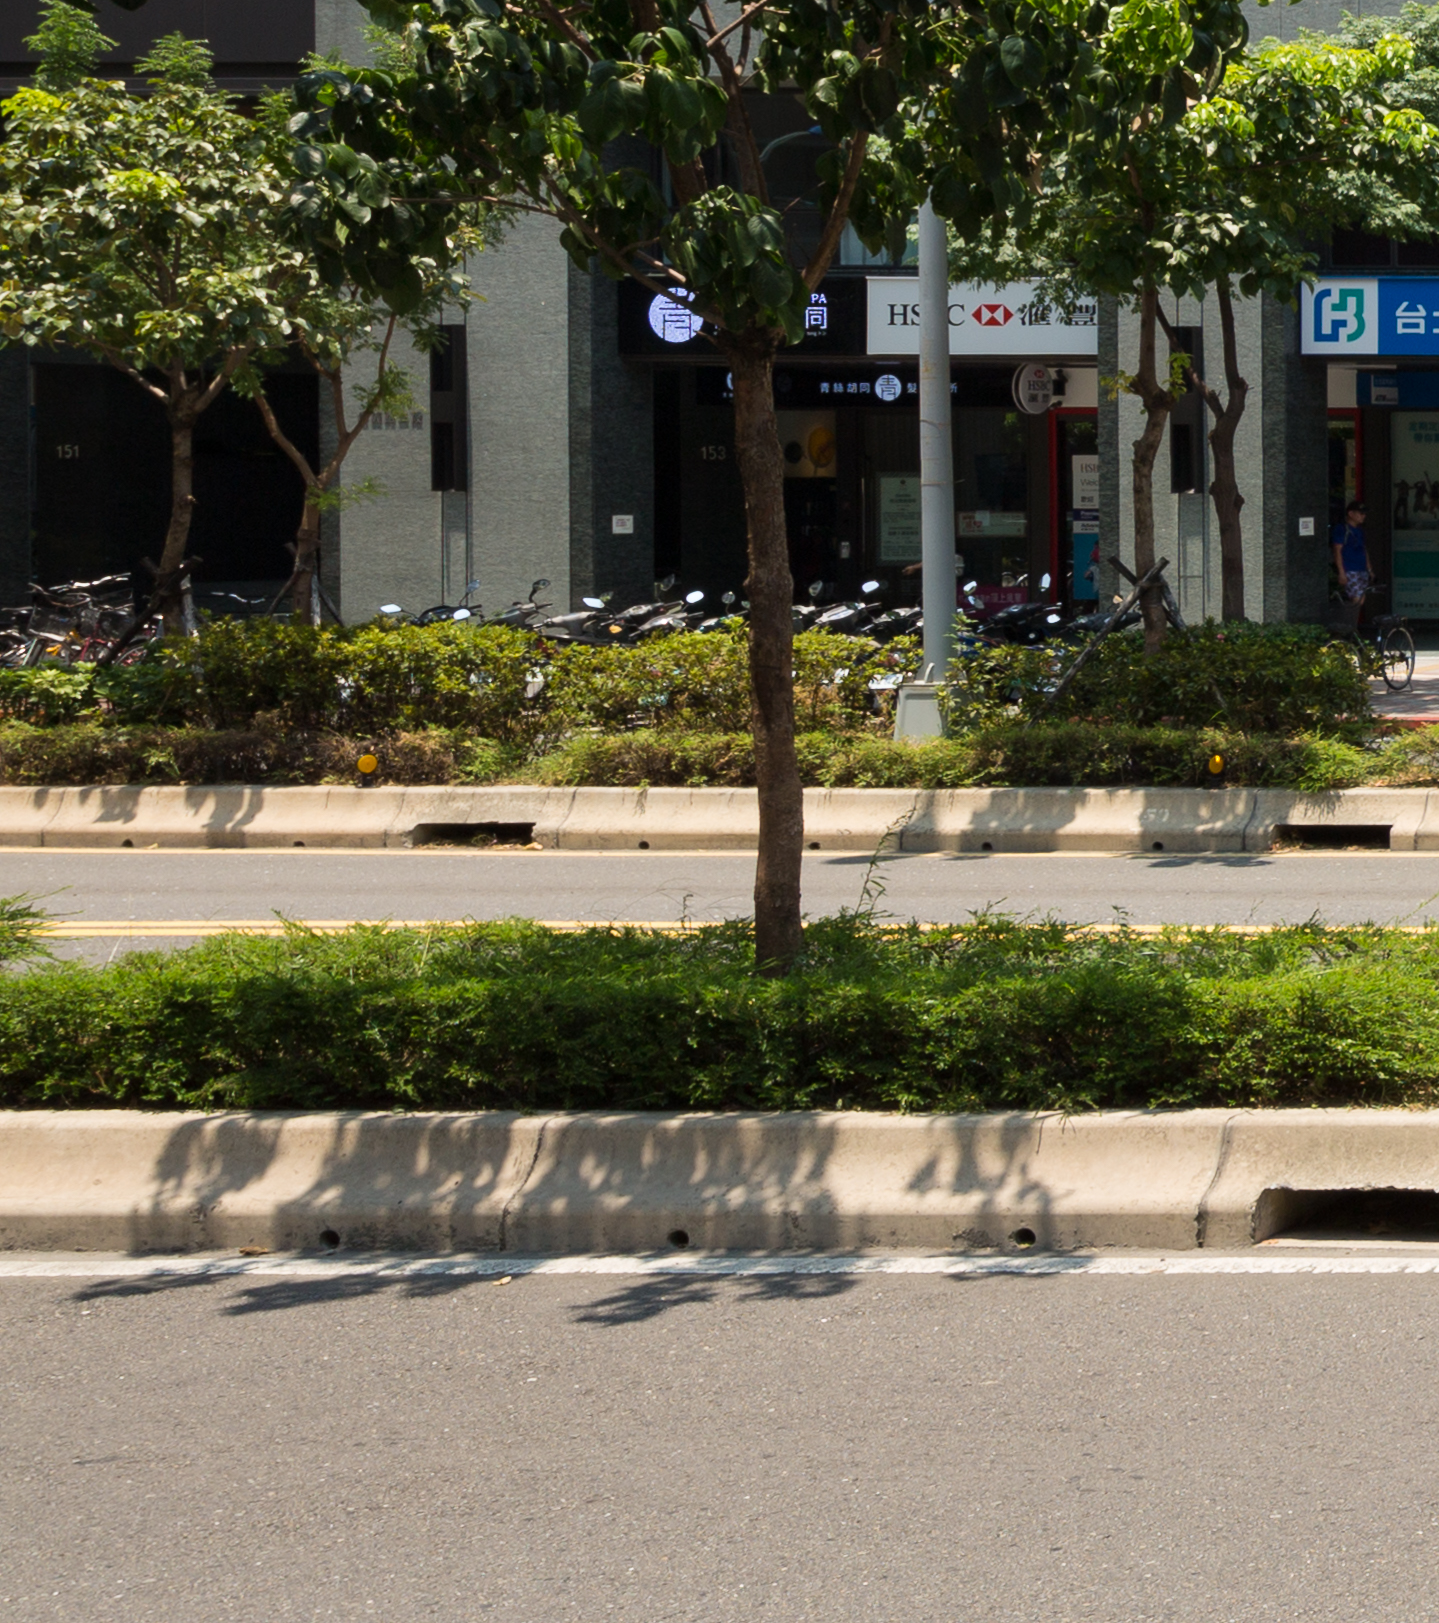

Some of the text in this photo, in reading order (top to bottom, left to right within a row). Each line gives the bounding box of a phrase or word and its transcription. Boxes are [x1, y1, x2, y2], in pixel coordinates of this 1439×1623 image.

[887, 304, 965, 326] HSC
[56, 444, 79, 458] 151
[701, 446, 727, 460] 153
